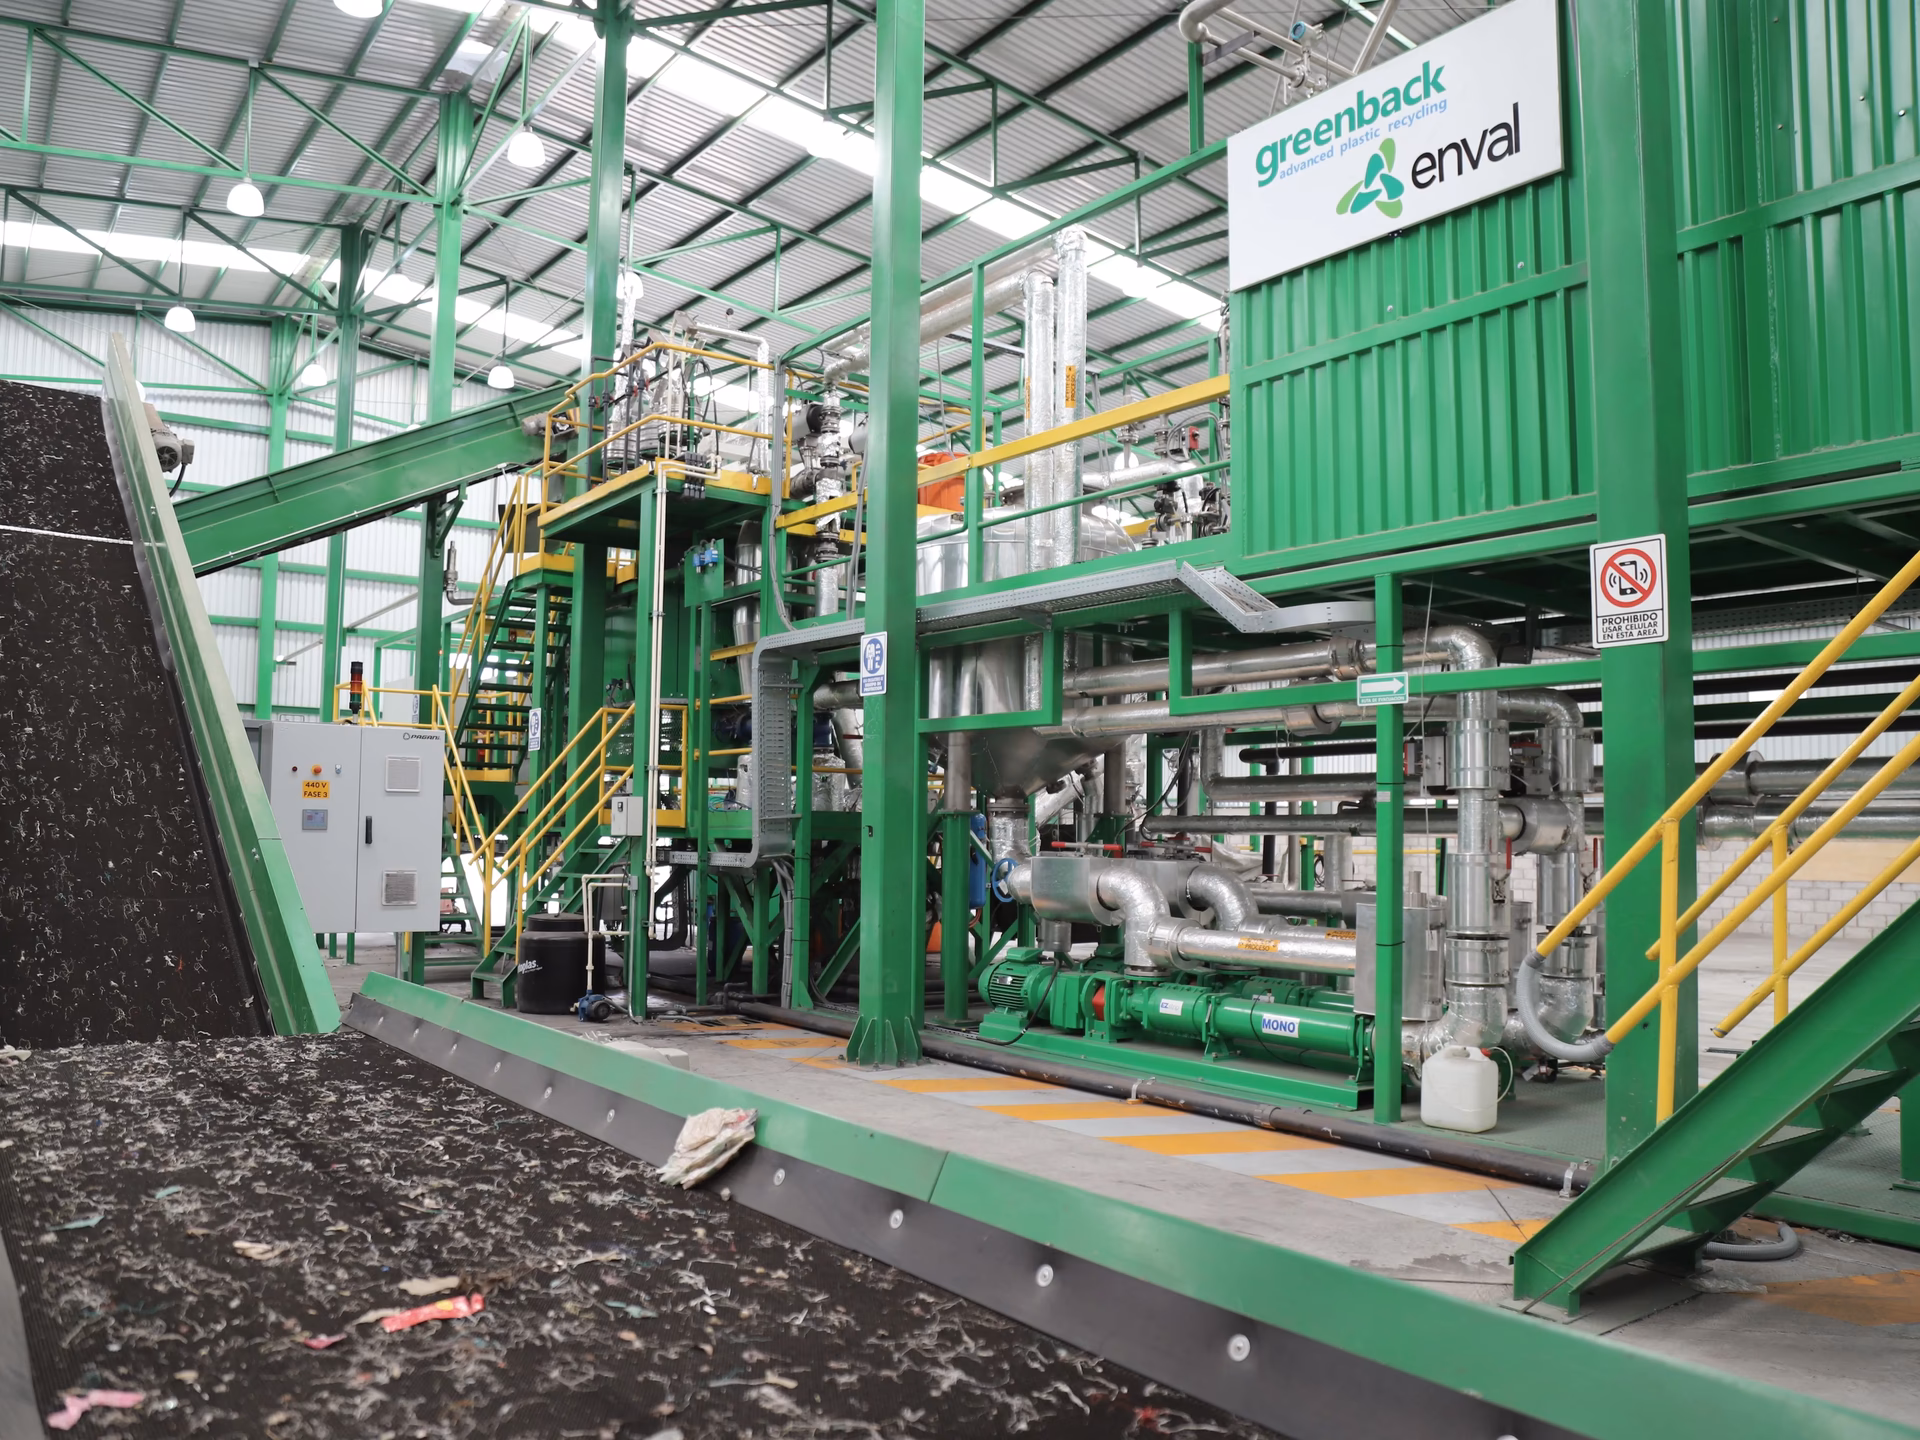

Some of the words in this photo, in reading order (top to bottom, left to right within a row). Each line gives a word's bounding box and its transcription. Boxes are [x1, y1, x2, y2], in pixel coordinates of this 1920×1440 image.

[1256, 61, 1446, 187] greenback
[1279, 145, 1335, 179] advanced
[1340, 127, 1381, 156] plastic
[1388, 99, 1447, 132] recycling
[1411, 102, 1521, 189] enval
[1602, 612, 1658, 626] PROHIBIDO
[1602, 624, 1622, 633] USAR
[1625, 621, 1658, 631] CELULAR
[1616, 631, 1634, 639] ESTA
[1637, 628, 1658, 636] AREA
[1262, 1018, 1296, 1033] MONO
